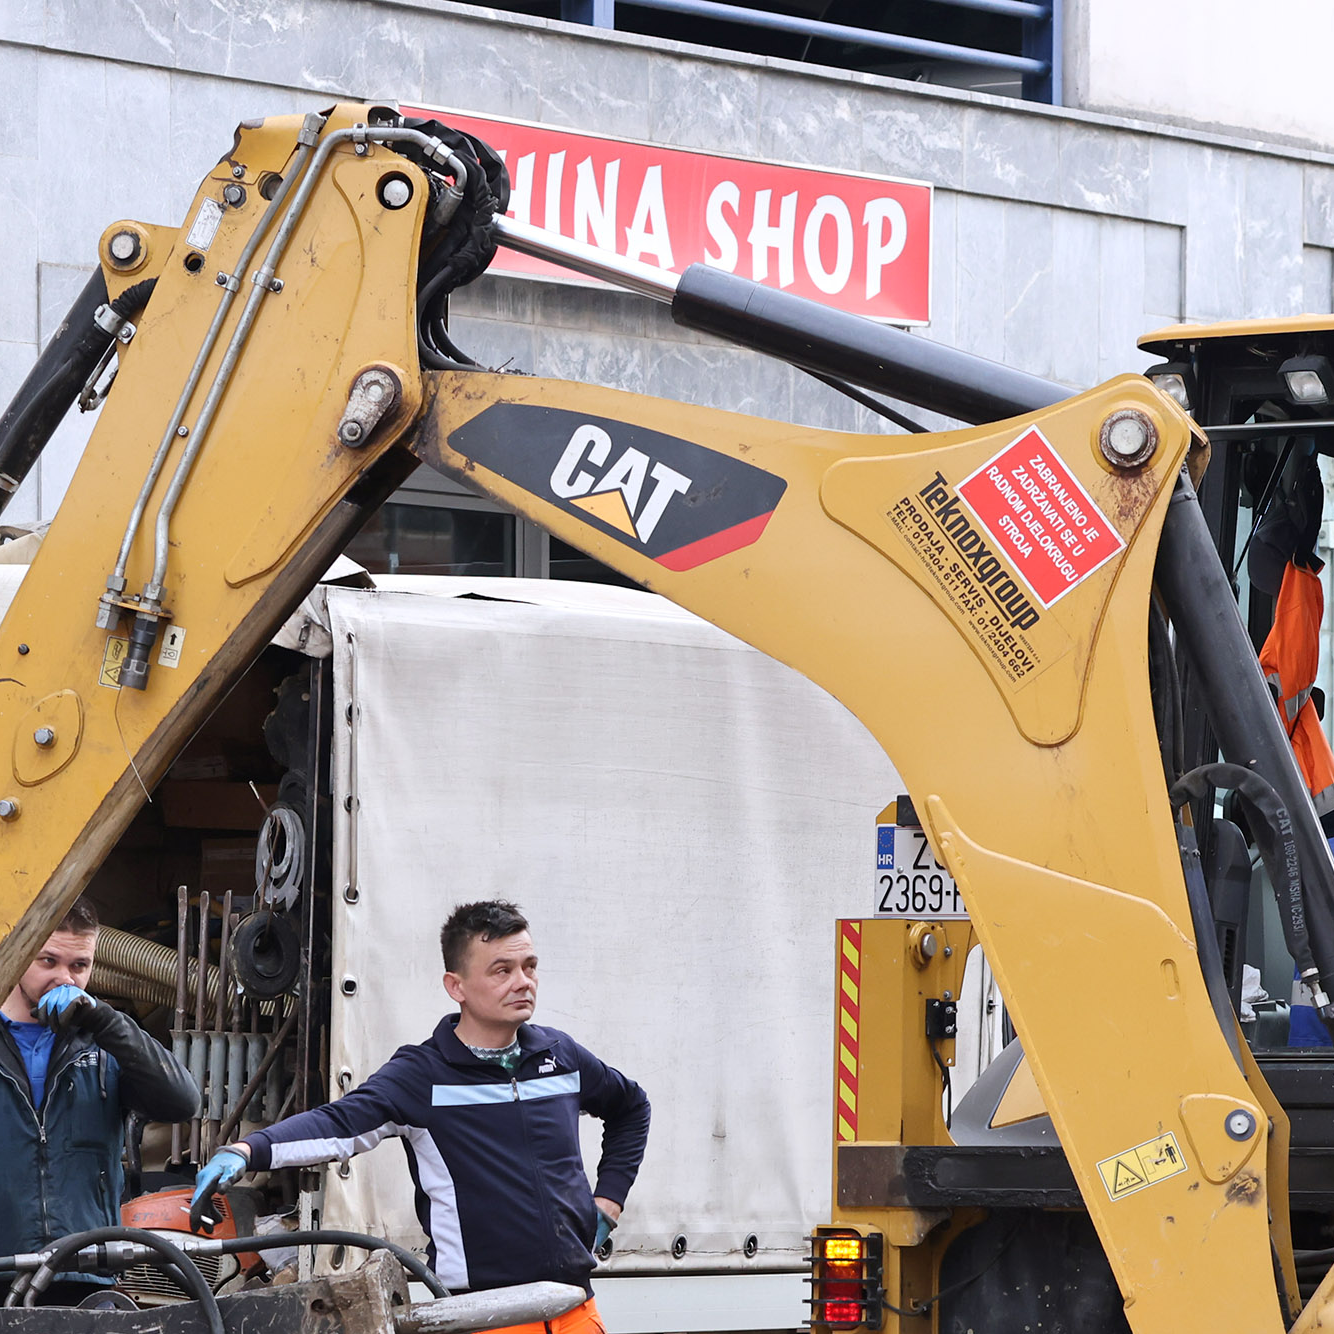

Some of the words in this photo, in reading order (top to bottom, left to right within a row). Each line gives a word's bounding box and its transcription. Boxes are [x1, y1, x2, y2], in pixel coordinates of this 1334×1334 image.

[499, 150, 676, 270] HINA
[703, 180, 908, 300] SHOP
[550, 424, 693, 545] CAT
[986, 466, 1027, 514] RADNOM
[1021, 511, 1078, 581] DJELOKRUGU
[999, 515, 1032, 558] STROJA
[1012, 465, 1066, 531] ZADRŽAVATI
[1060, 529, 1078, 547] SE
[1073, 544, 1085, 556] U
[1029, 455, 1087, 526] ZABRANJENO
[1083, 527, 1099, 542] JE
[893, 504, 912, 530] TEL.:
[913, 532, 944, 571] 01/2404
[944, 573, 959, 591] 611
[959, 593, 977, 616] FAX:
[977, 618, 1009, 657] 01/2404
[1009, 659, 1025, 678] 662
[900, 497, 945, 555] PRODAJA
[950, 563, 985, 607] SERVIS
[989, 616, 1034, 672] DIJELOVI
[919, 471, 1040, 631] Teknoxgroup
[878, 854, 893, 865] HR
[913, 833, 947, 870] Z
[1276, 808, 1294, 835] CAT
[1289, 880, 1302, 903] MSHA
